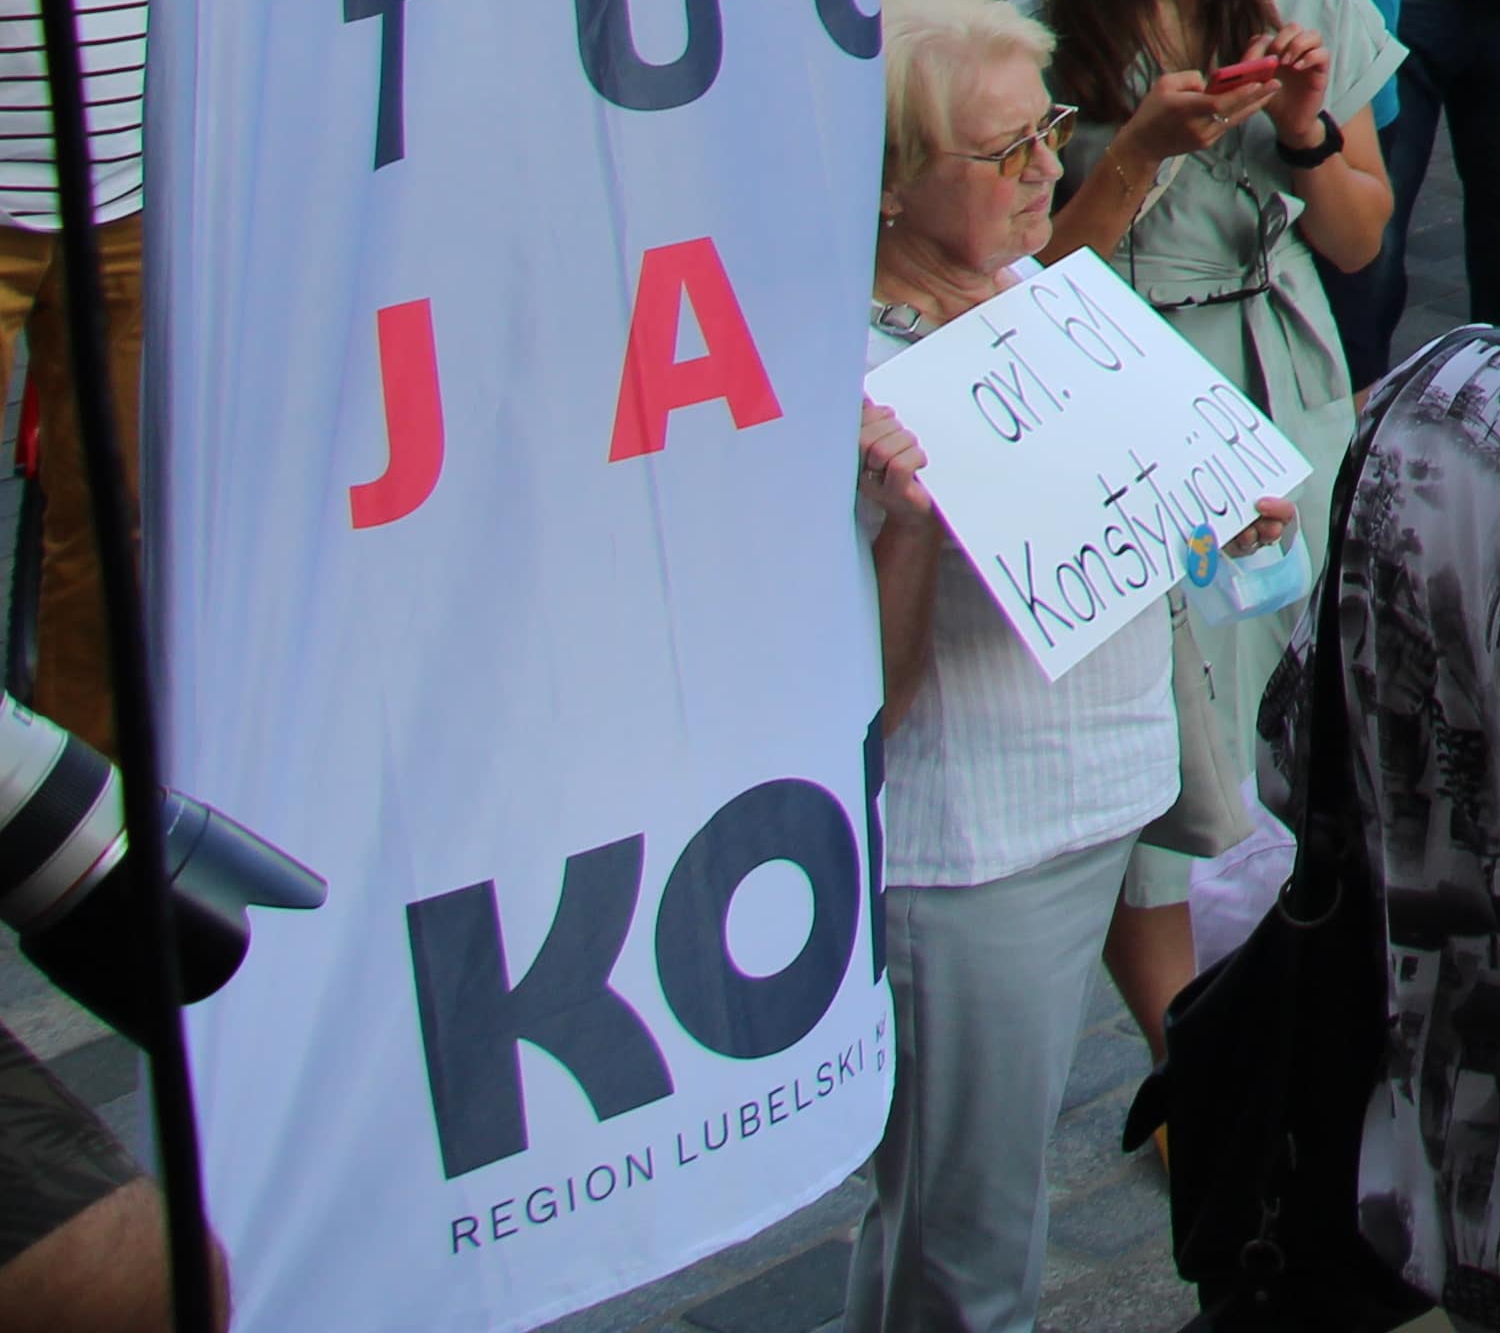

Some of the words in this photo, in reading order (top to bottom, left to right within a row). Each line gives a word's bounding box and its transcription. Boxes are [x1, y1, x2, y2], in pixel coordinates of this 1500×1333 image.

[348, 235, 784, 531] JA
[970, 315, 1073, 444] art.
[1030, 271, 1147, 372] 61
[1191, 381, 1290, 491] RP
[449, 1145, 656, 1256] REGION
[676, 1038, 868, 1171] LUBELSKI
